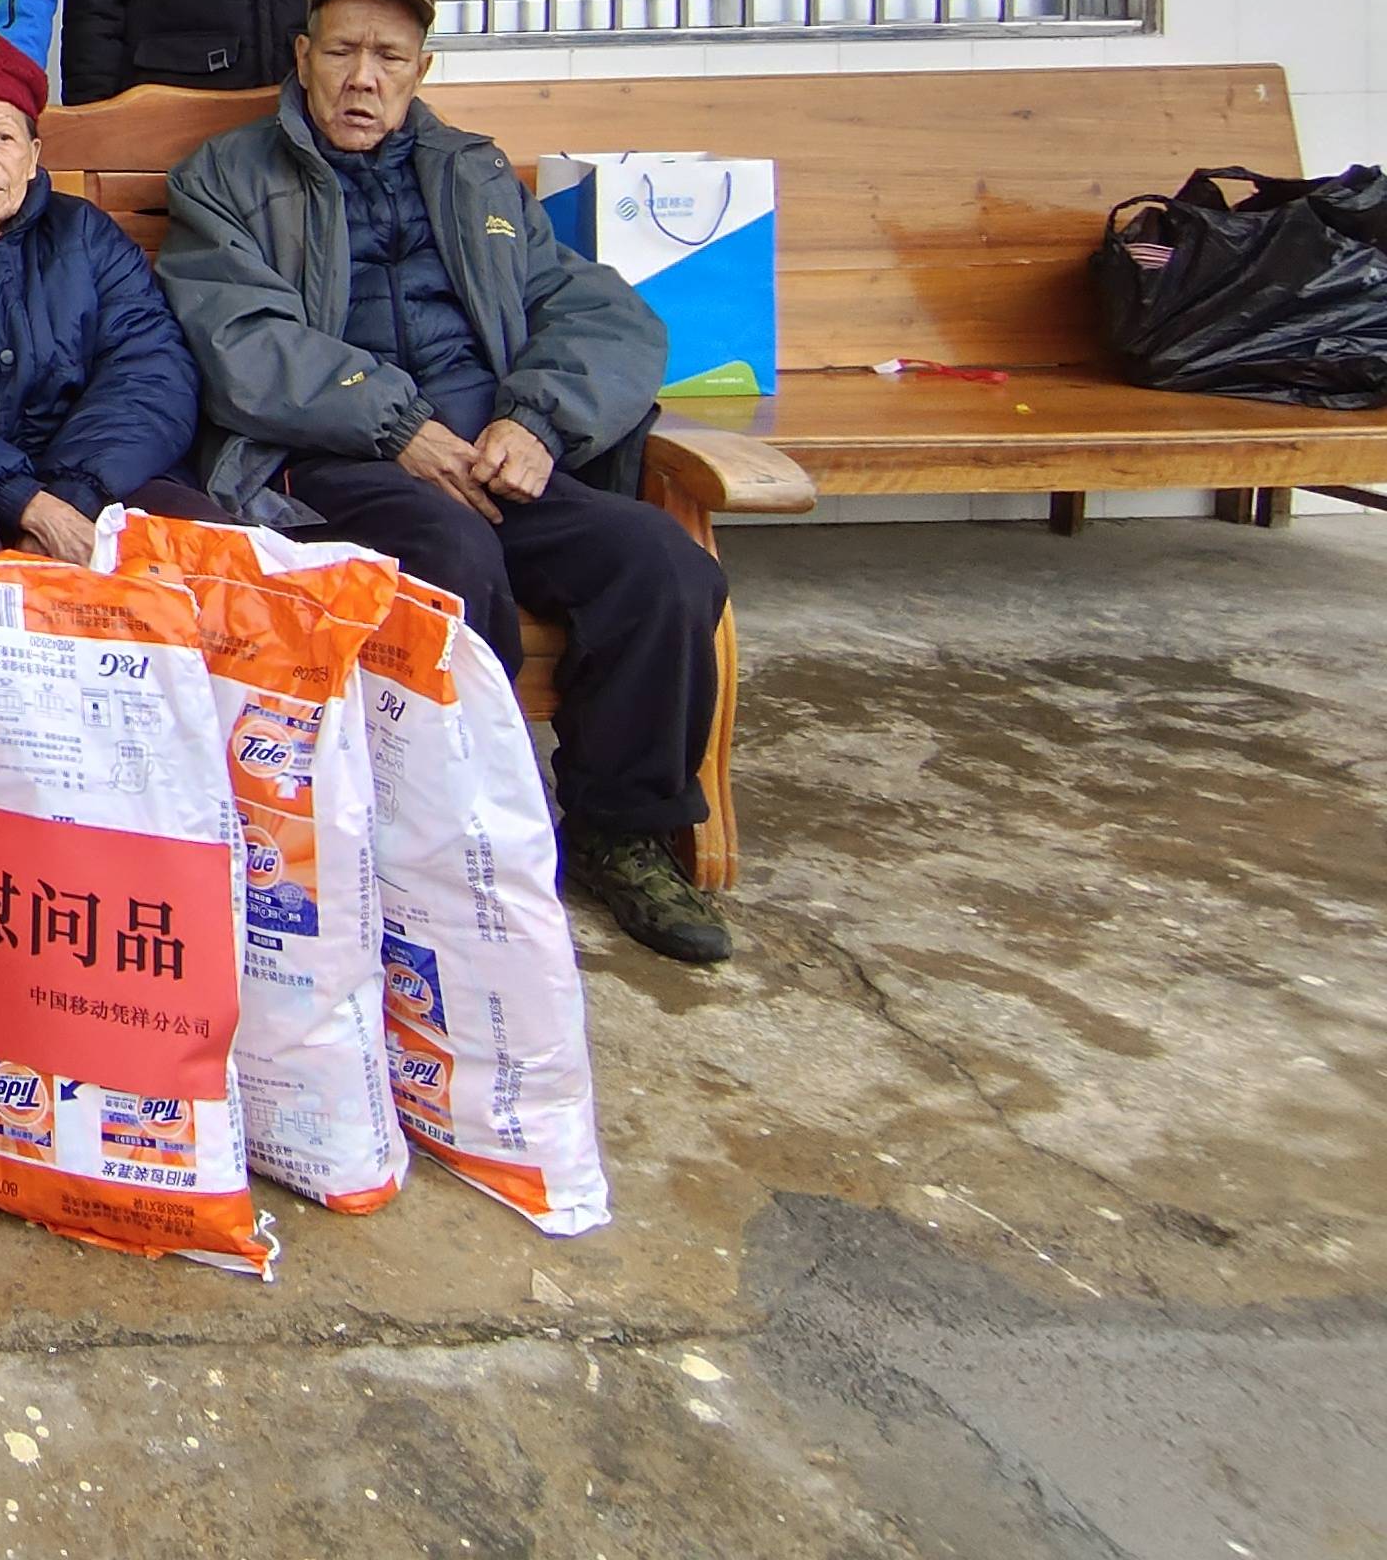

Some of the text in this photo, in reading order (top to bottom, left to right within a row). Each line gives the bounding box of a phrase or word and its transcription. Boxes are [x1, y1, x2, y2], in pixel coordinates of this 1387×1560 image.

[98, 652, 150, 680] P&G
[376, 690, 406, 722] P&G
[239, 736, 287, 764] Tide
[393, 974, 428, 1002] Tide
[28, 985, 211, 1039] 中国移动凭祥分公司
[403, 1060, 441, 1088] Tide
[142, 1099, 183, 1121] Tide
[100, 1159, 198, 1188] 新旧包装混发
